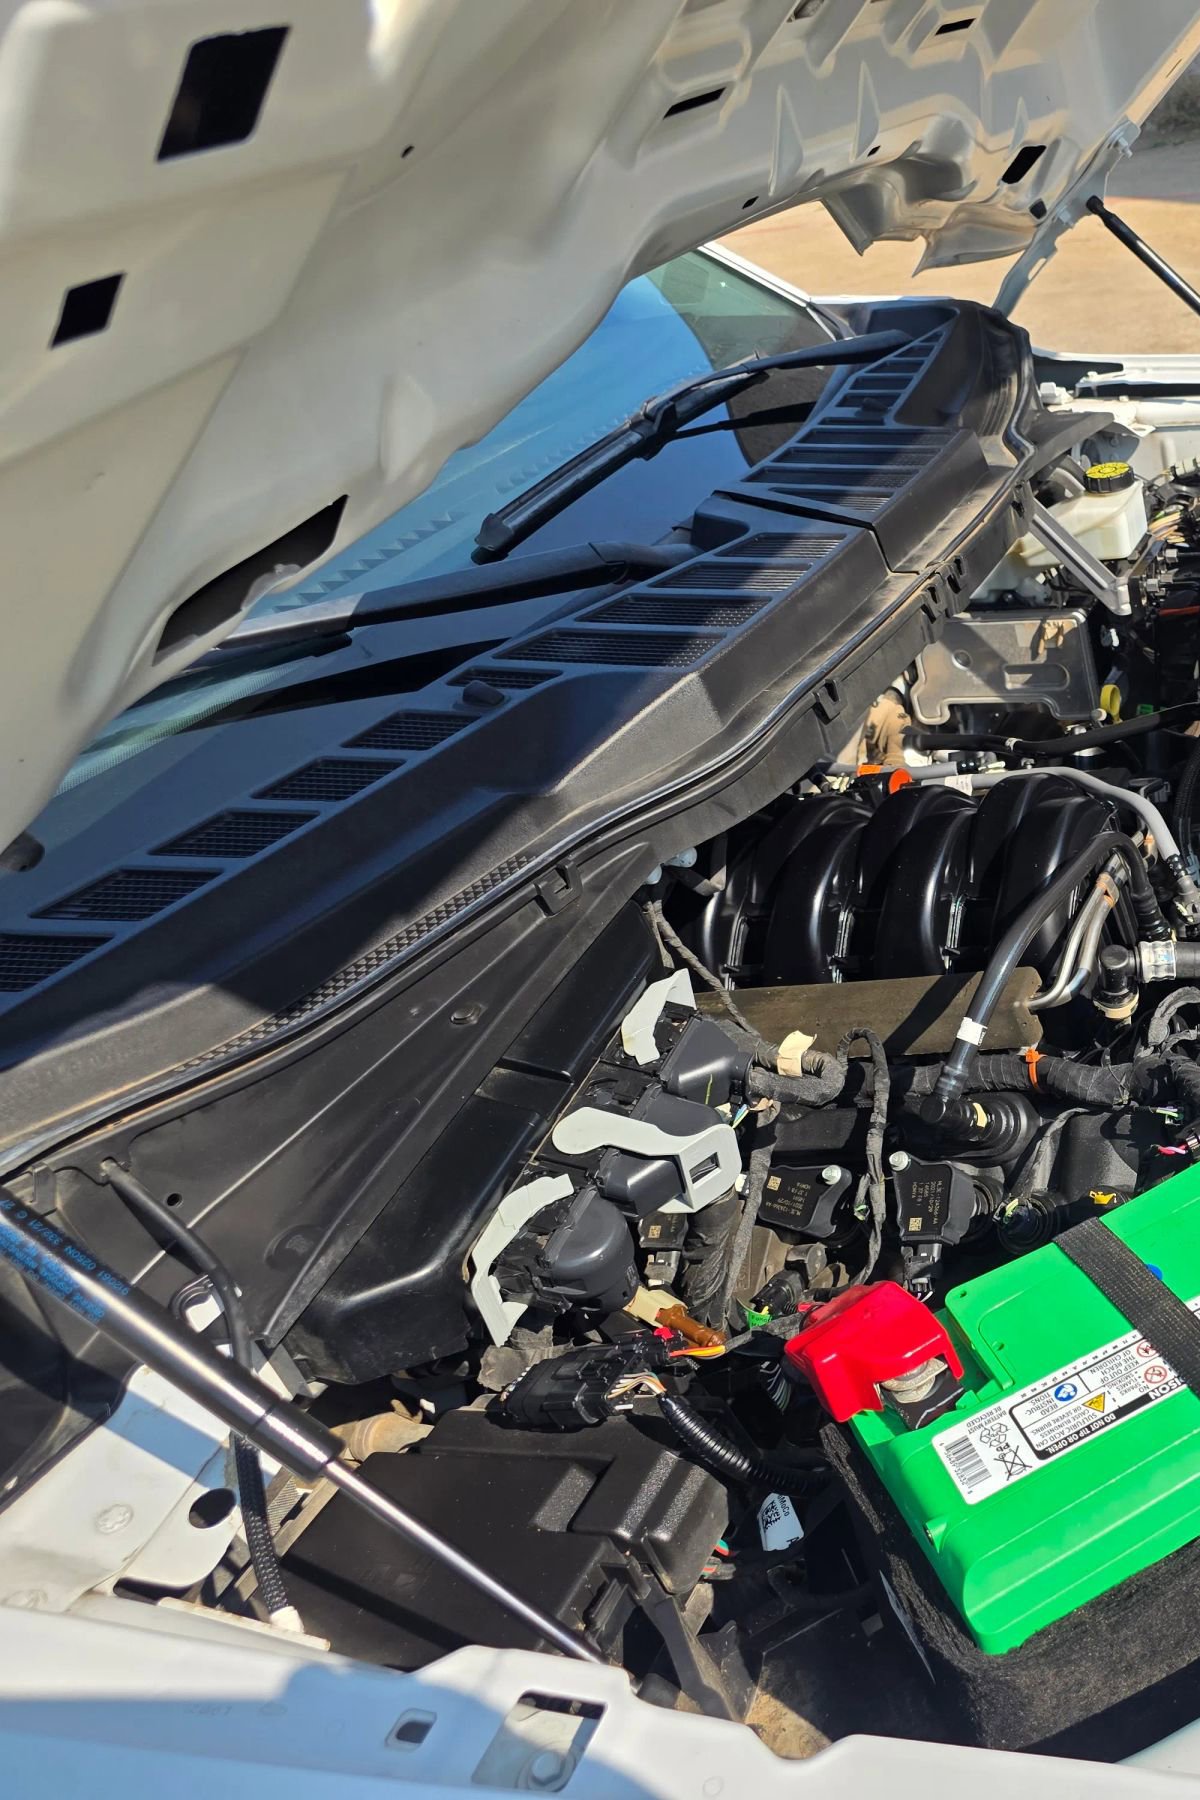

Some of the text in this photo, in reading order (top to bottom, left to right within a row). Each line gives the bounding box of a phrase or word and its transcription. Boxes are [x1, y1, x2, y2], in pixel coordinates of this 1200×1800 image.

[1121, 1349, 1132, 1357] OF
[1099, 1360, 1140, 1384] KEEP OUT OF
[1100, 1354, 1136, 1376] THE REACH
[1106, 1372, 1134, 1389] SMOKING
[1115, 1377, 1137, 1391] FLAMES
[1119, 1381, 1141, 1396] SPARKS
[1137, 1384, 1150, 1393] NO
[1024, 1397, 1055, 1416] INSTRUC-
[1028, 1392, 1051, 1406] TIONS.
[1040, 1403, 1059, 1416] READ
[1051, 1410, 1073, 1424] SEVERE
[1072, 1405, 1082, 1413] OR
[965, 1410, 994, 1428] RECYCLED
[967, 1410, 1007, 1434] BATTERY MUST
[1039, 1408, 1090, 1438] CAUSE BLINDNESS
[1034, 1412, 1098, 1449] SULFURIC ACID CAN
[1045, 1412, 1117, 1455] DO NOT TIP OR OPEN.
[995, 1442, 1011, 1454] Pb
